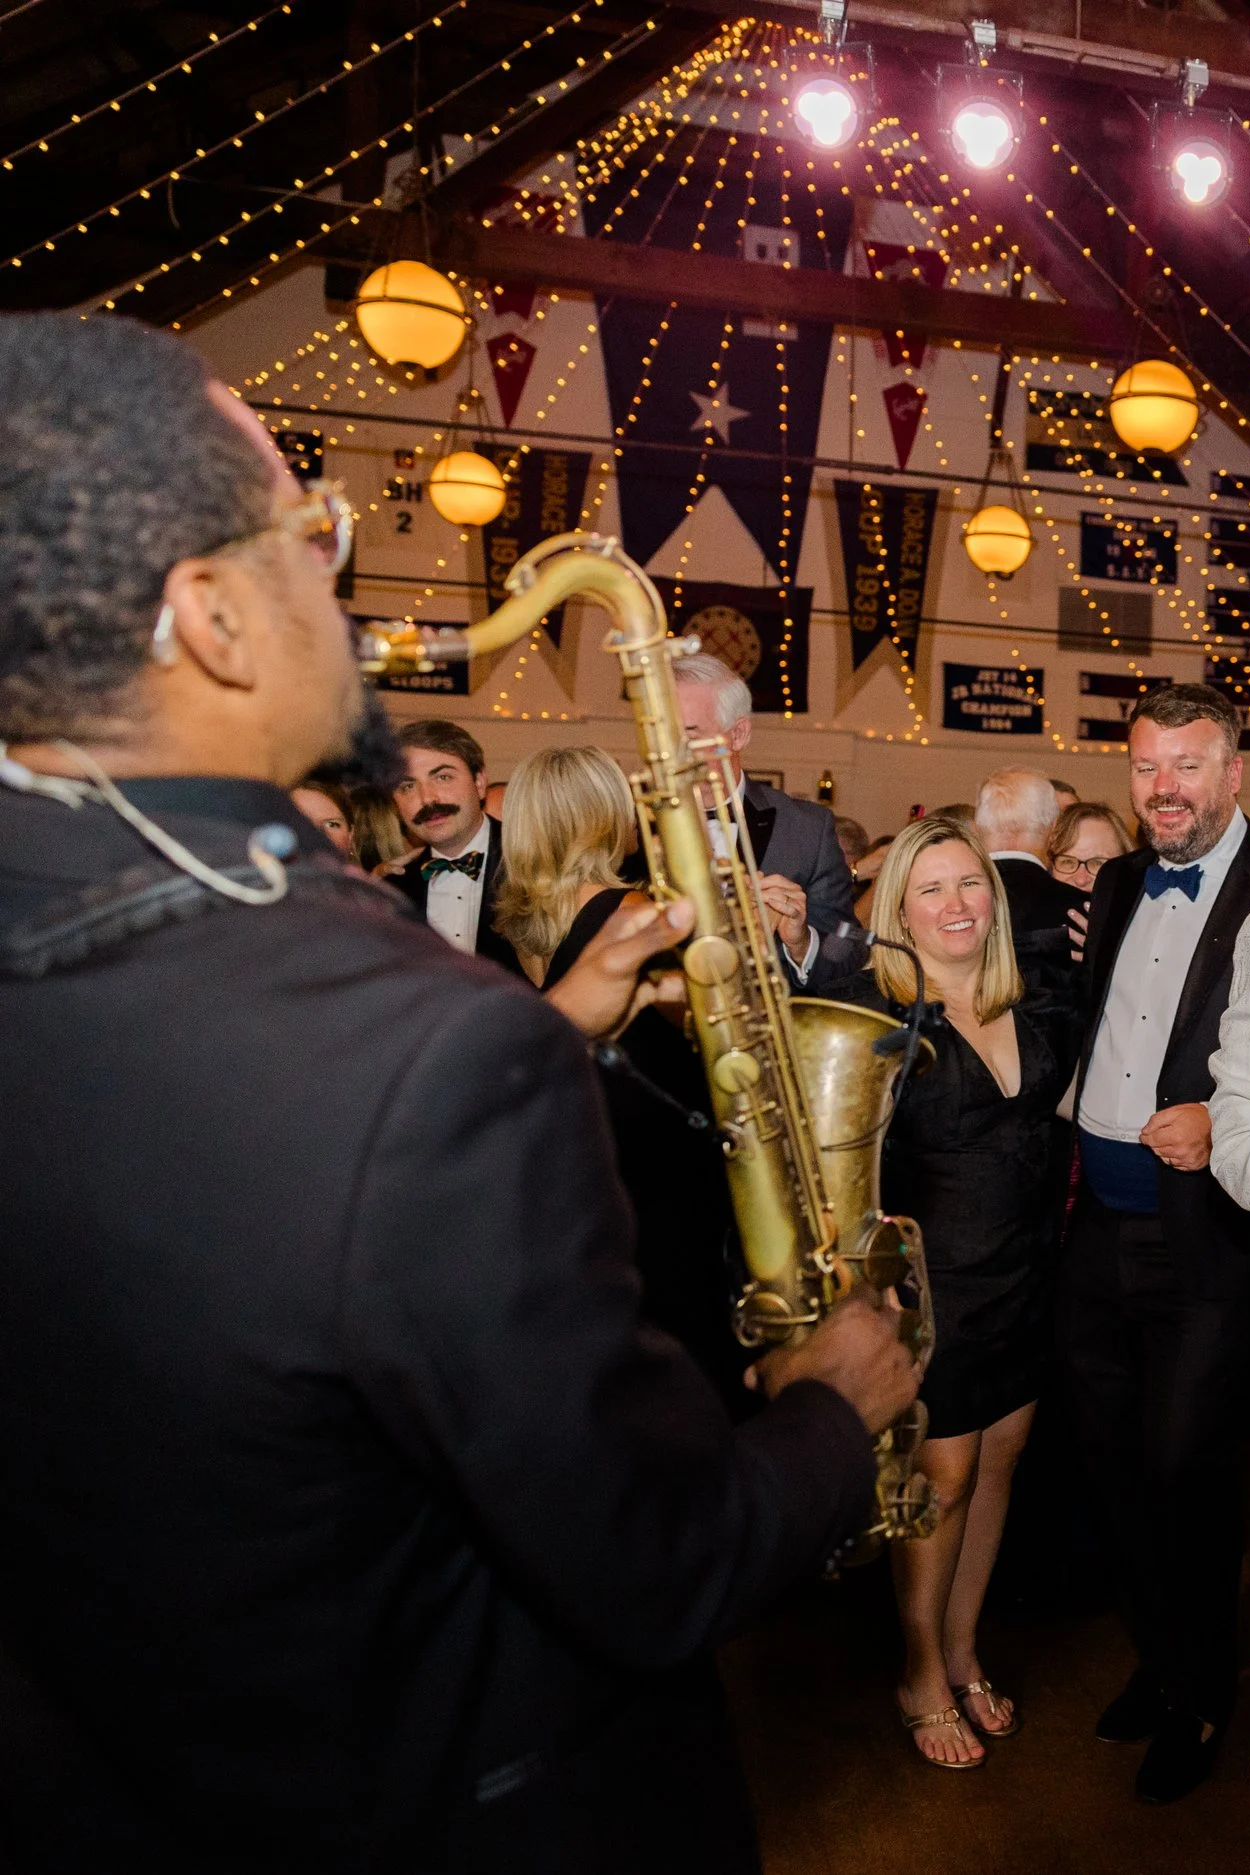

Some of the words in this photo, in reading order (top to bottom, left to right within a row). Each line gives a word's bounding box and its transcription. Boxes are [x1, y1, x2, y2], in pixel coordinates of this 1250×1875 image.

[396, 511, 413, 534] 2
[858, 489, 885, 555] CUP
[901, 491, 926, 566] HORACE
[852, 562, 881, 633] 1939
